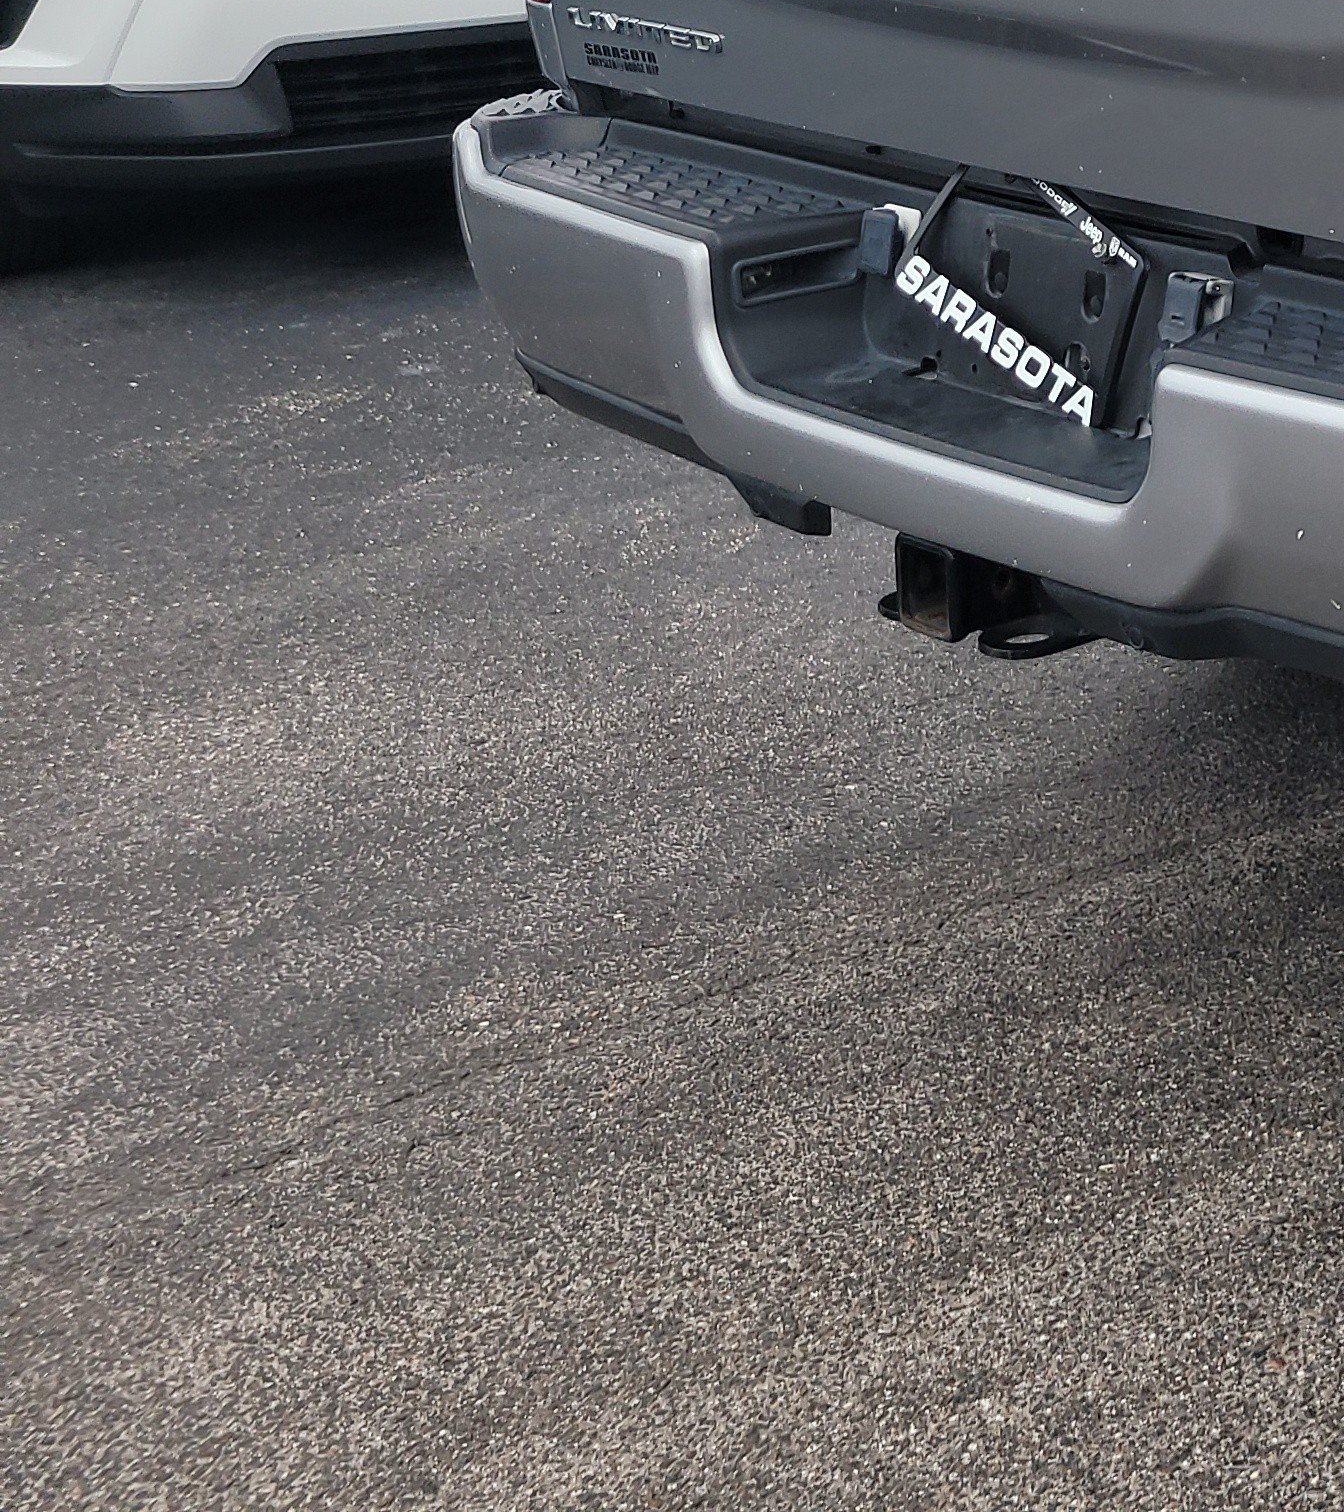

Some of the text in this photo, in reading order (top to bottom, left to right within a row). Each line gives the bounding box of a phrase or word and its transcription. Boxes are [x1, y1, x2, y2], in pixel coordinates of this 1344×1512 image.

[566, 6, 725, 54] LIMITED
[583, 41, 658, 65] SARASOTA
[1079, 216, 1103, 245] Jeep
[896, 255, 1094, 428] SARASOTA
